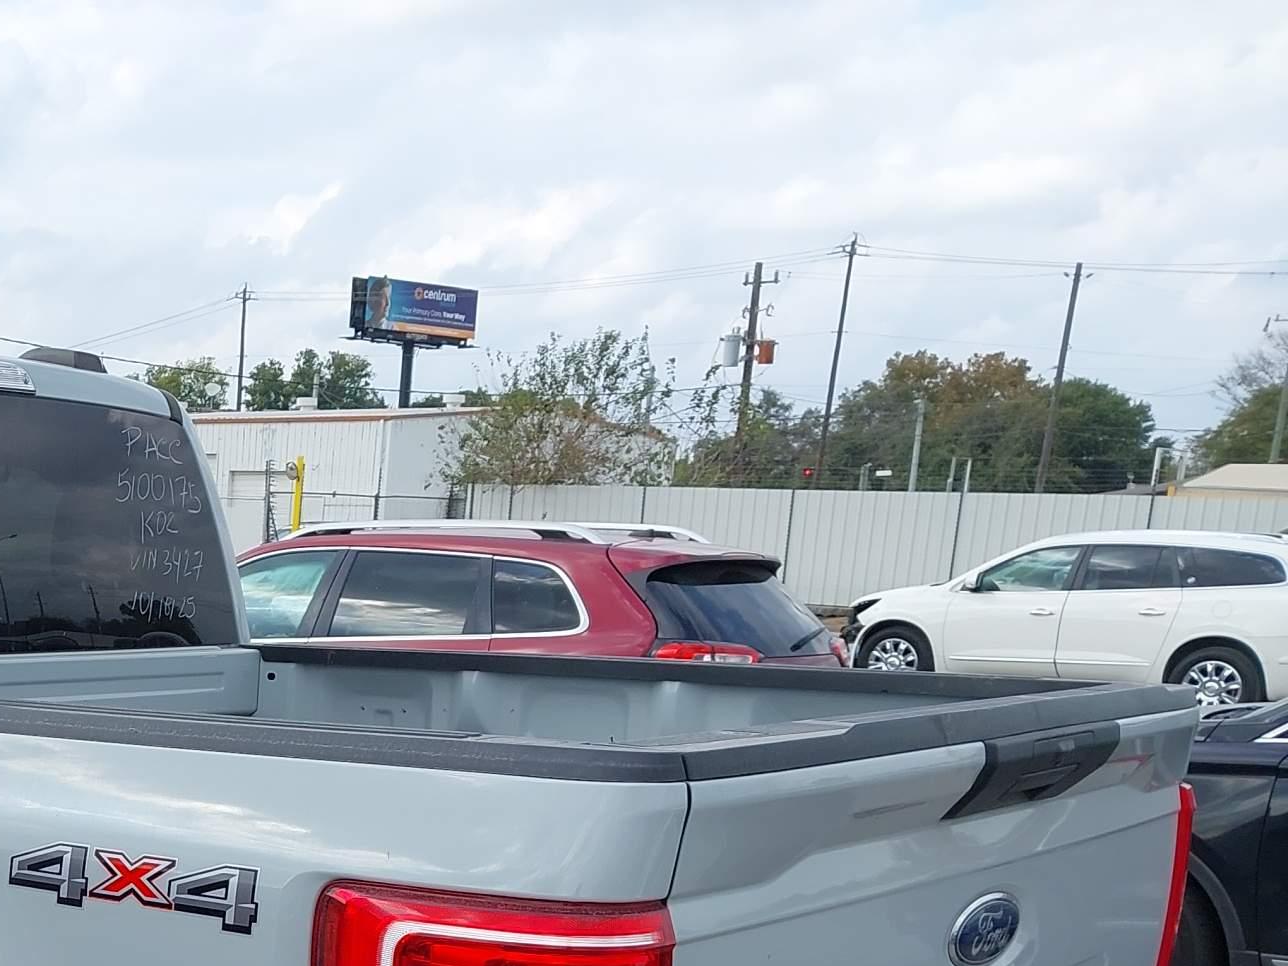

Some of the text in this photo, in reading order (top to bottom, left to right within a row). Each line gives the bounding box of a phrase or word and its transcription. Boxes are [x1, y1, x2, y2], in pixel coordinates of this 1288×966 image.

[423, 289, 456, 302] centrum
[115, 468, 202, 514] 5100175
[130, 549, 204, 584] VIN 3427
[971, 909, 1013, 956] Ford
